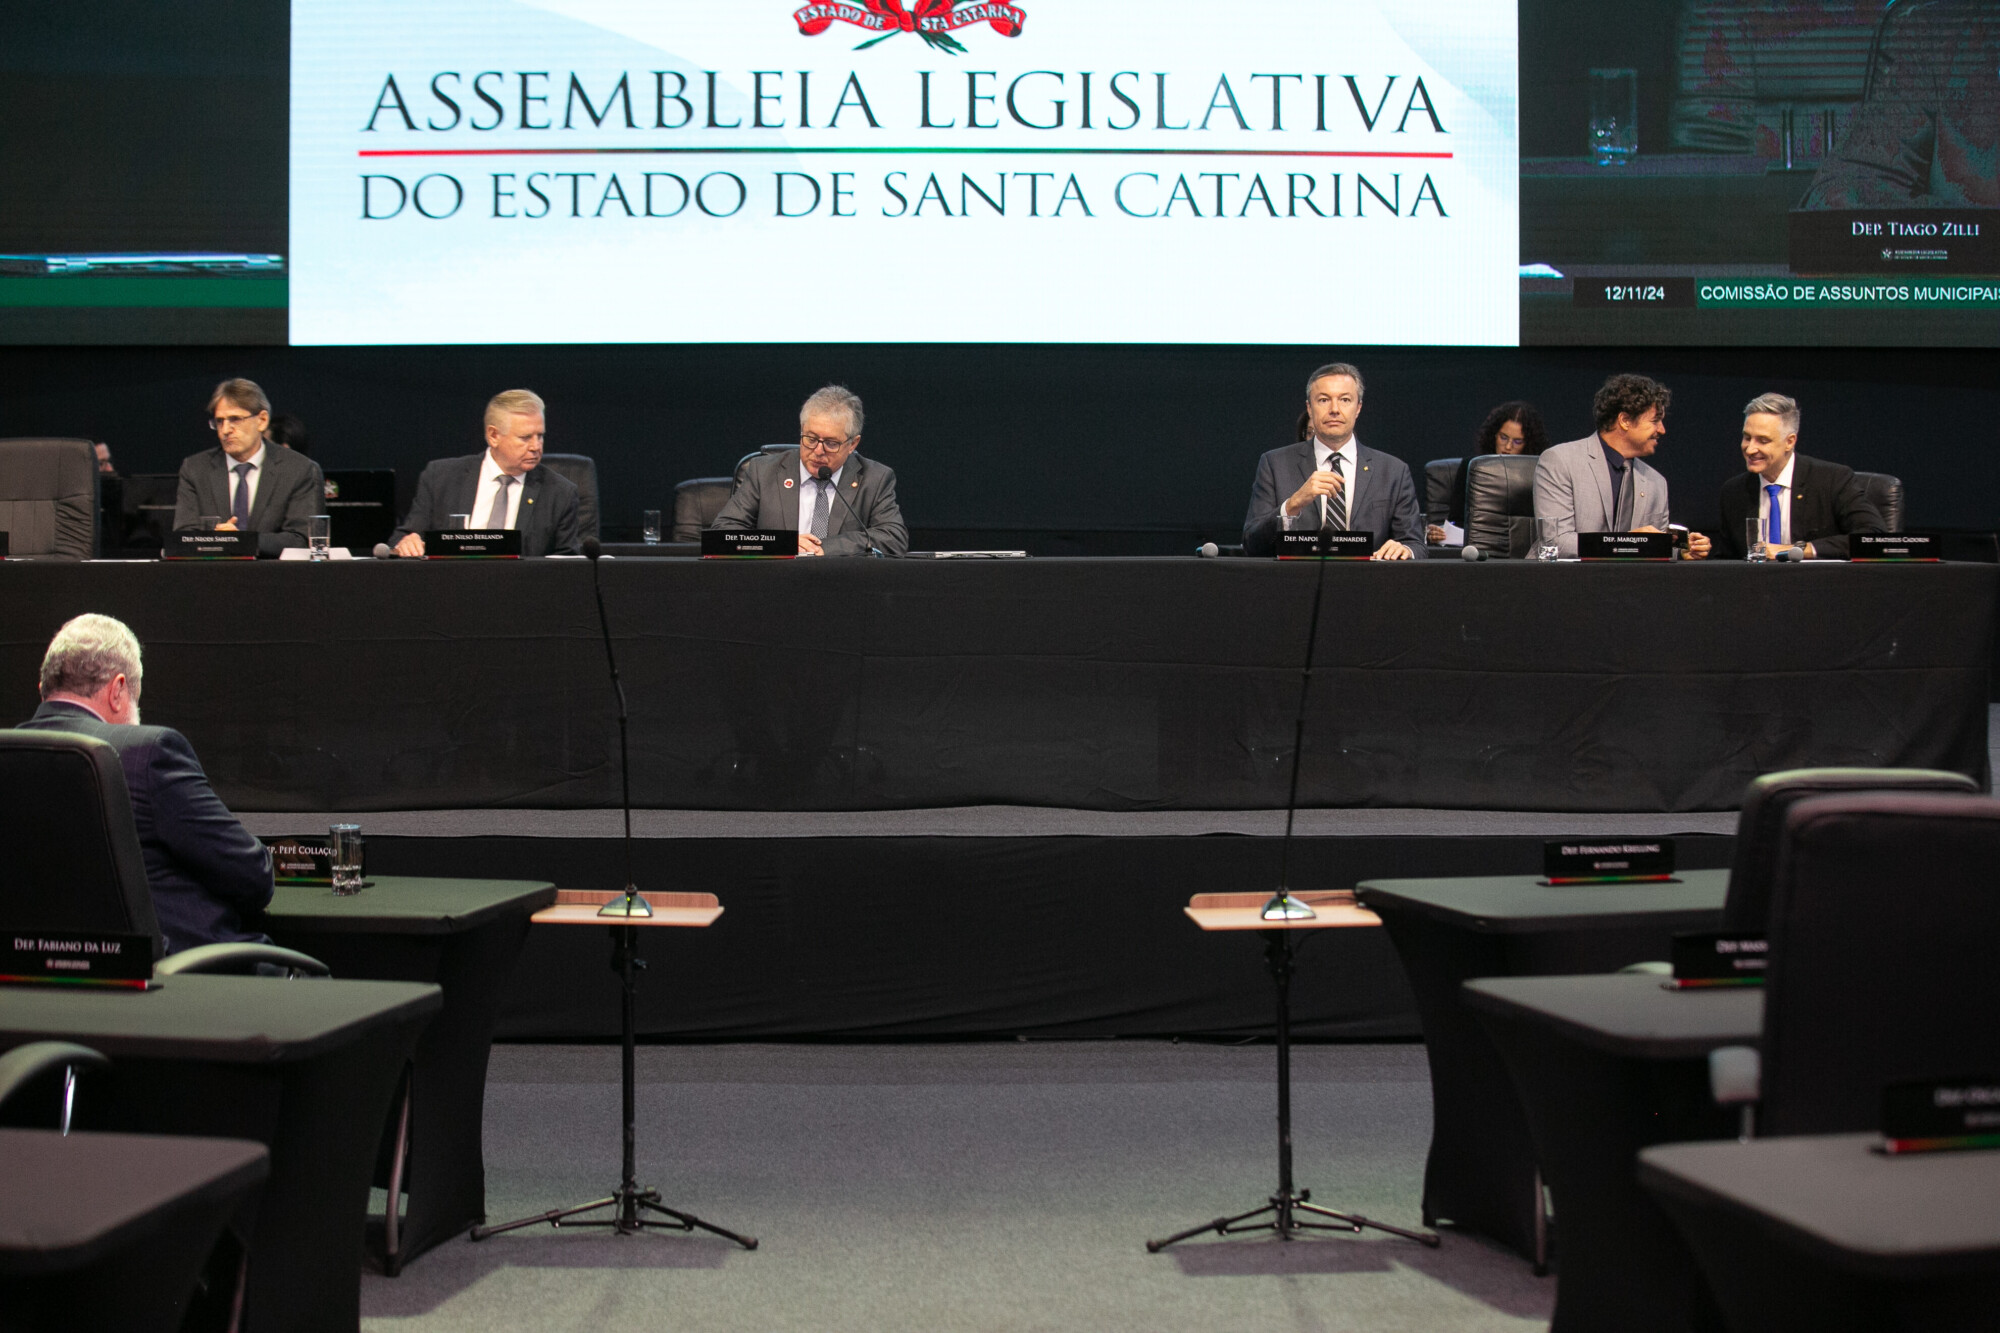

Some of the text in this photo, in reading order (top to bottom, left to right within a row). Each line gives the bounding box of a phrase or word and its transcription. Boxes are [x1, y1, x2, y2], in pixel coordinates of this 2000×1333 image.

[798, 4, 1020, 31] ESTADO DE STA CATARINA
[359, 70, 1451, 133] ASSEMBLEIA LEGISLATIVA
[360, 172, 1450, 219] DO ESTADO DE SANTA CATARINA
[1852, 221, 1980, 236] DEP. TIAGO ZILLI
[1604, 286, 1665, 300] 12/11/24
[1700, 283, 2000, 301] COMISSÃO DE ASSUNTOS MUNICIPAI
